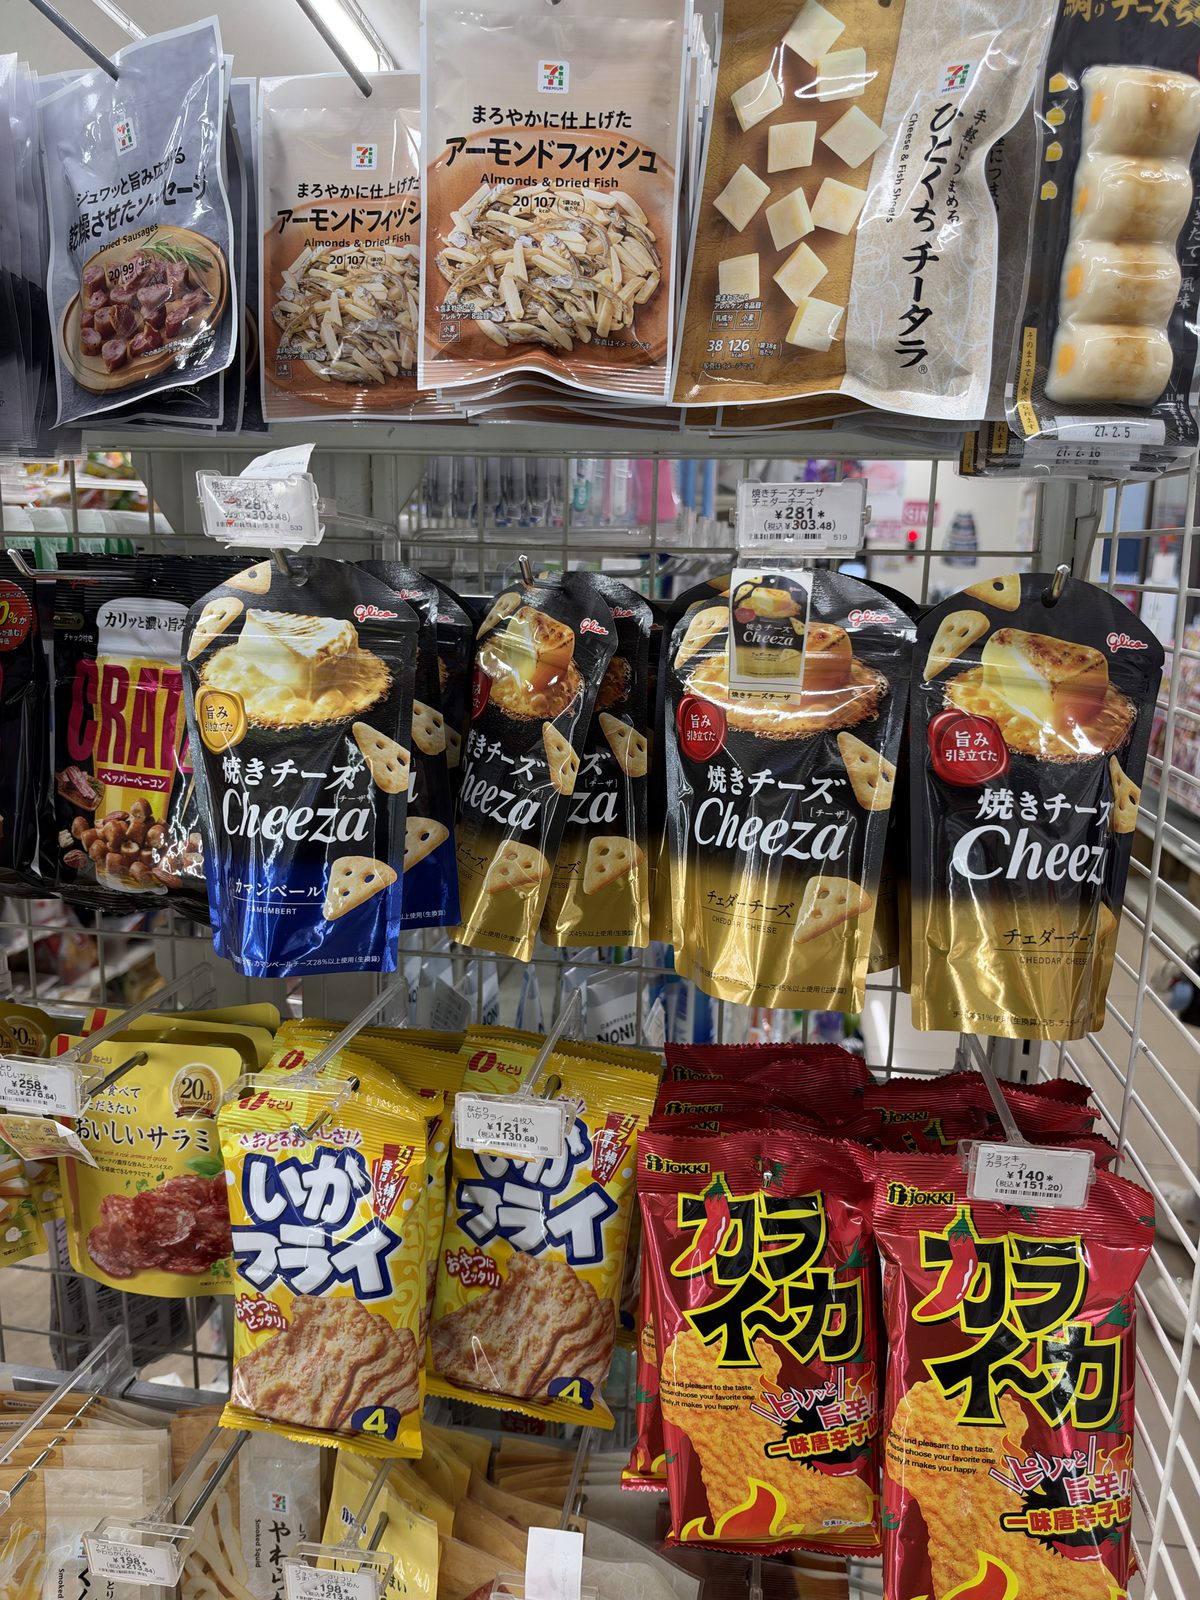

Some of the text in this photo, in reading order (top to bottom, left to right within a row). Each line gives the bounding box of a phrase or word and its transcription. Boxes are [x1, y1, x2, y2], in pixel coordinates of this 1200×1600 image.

[472, 105, 632, 130] まろやかに仕上げた
[901, 113, 919, 151] Cheese
[445, 136, 658, 174] アーモンドフィッシュ
[896, 164, 907, 183] Fish
[945, 109, 987, 222] 手軽につまめる
[297, 176, 421, 200] まろやかに仕上げた
[480, 173, 619, 188] Almonds & Dried Fish
[512, 195, 529, 207] 20
[533, 196, 556, 208] 107
[100, 223, 159, 253] Dried Sausages
[304, 233, 411, 248] Almonds & Dried Fish
[329, 255, 343, 265] 20
[347, 256, 365, 265] 107
[707, 339, 723, 352] 38
[728, 339, 750, 352] 126
[752, 488, 825, 498] 焼きチーズチーザ
[752, 498, 815, 507] チェダーチーズ
[353, 604, 398, 623] Glico
[848, 609, 897, 628] Glico
[580, 617, 610, 635] Glico
[745, 622, 794, 634] 焼きチーズ
[742, 629, 794, 647] Cheeza
[1107, 632, 1148, 653] Glico
[731, 691, 791, 701] 焼きチーズチーザ
[205, 706, 228, 719] 旨み
[690, 713, 711, 728] 旨み
[687, 730, 717, 742] 引き立てた
[955, 731, 990, 748] 旨み
[945, 749, 998, 763] 引き立てた
[222, 755, 366, 790] 焼きチーズ
[102, 773, 167, 790] ペッパーベーコン
[706, 764, 847, 805] 焼きチーズ
[460, 756, 542, 831] heeza
[222, 788, 371, 843] Cheeza
[693, 797, 850, 861] Cheeza
[235, 878, 324, 897] カマンベール
[706, 889, 796, 919] チェダーチーズ
[746, 923, 778, 935] CHEESE
[1019, 956, 1061, 965] CHEDDAR
[93, 1055, 112, 1064] なとり
[496, 1062, 523, 1075] なとり
[180, 1077, 213, 1101] 20th
[266, 1100, 294, 1111] なとり
[467, 1105, 489, 1113] なとり
[467, 1112, 504, 1121] いかフライ
[75, 1118, 212, 1152] おいしいサラミ
[986, 1160, 1027, 1170] カライーカ
[987, 1152, 1020, 1162] ジョッキ
[662, 1161, 710, 1175] JOKKI
[908, 1190, 955, 1206] JOKKI
[461, 1181, 609, 1258] フライ
[670, 1189, 826, 1285] カラ
[231, 1223, 391, 1294] フライ
[446, 1254, 495, 1274] おやつに
[460, 1269, 501, 1288] ピッタリ!
[912, 1230, 1089, 1338] カラ
[234, 1298, 278, 1316] おやつに
[558, 1379, 585, 1404] 4
[675, 1389, 698, 1399] choose
[685, 1381, 712, 1390] pleasant
[681, 1401, 703, 1409] makes
[718, 1403, 741, 1411] happy.
[765, 1381, 837, 1421] ピリッと
[362, 1408, 389, 1434] 4
[918, 1440, 950, 1450] pleasant
[961, 1444, 974, 1452] the
[905, 1448, 998, 1465] choose your favorite one.
[911, 1461, 978, 1475] makes you happy.
[1006, 1450, 1088, 1490] ピリッと
[254, 1518, 262, 1568] Smoked Squid
